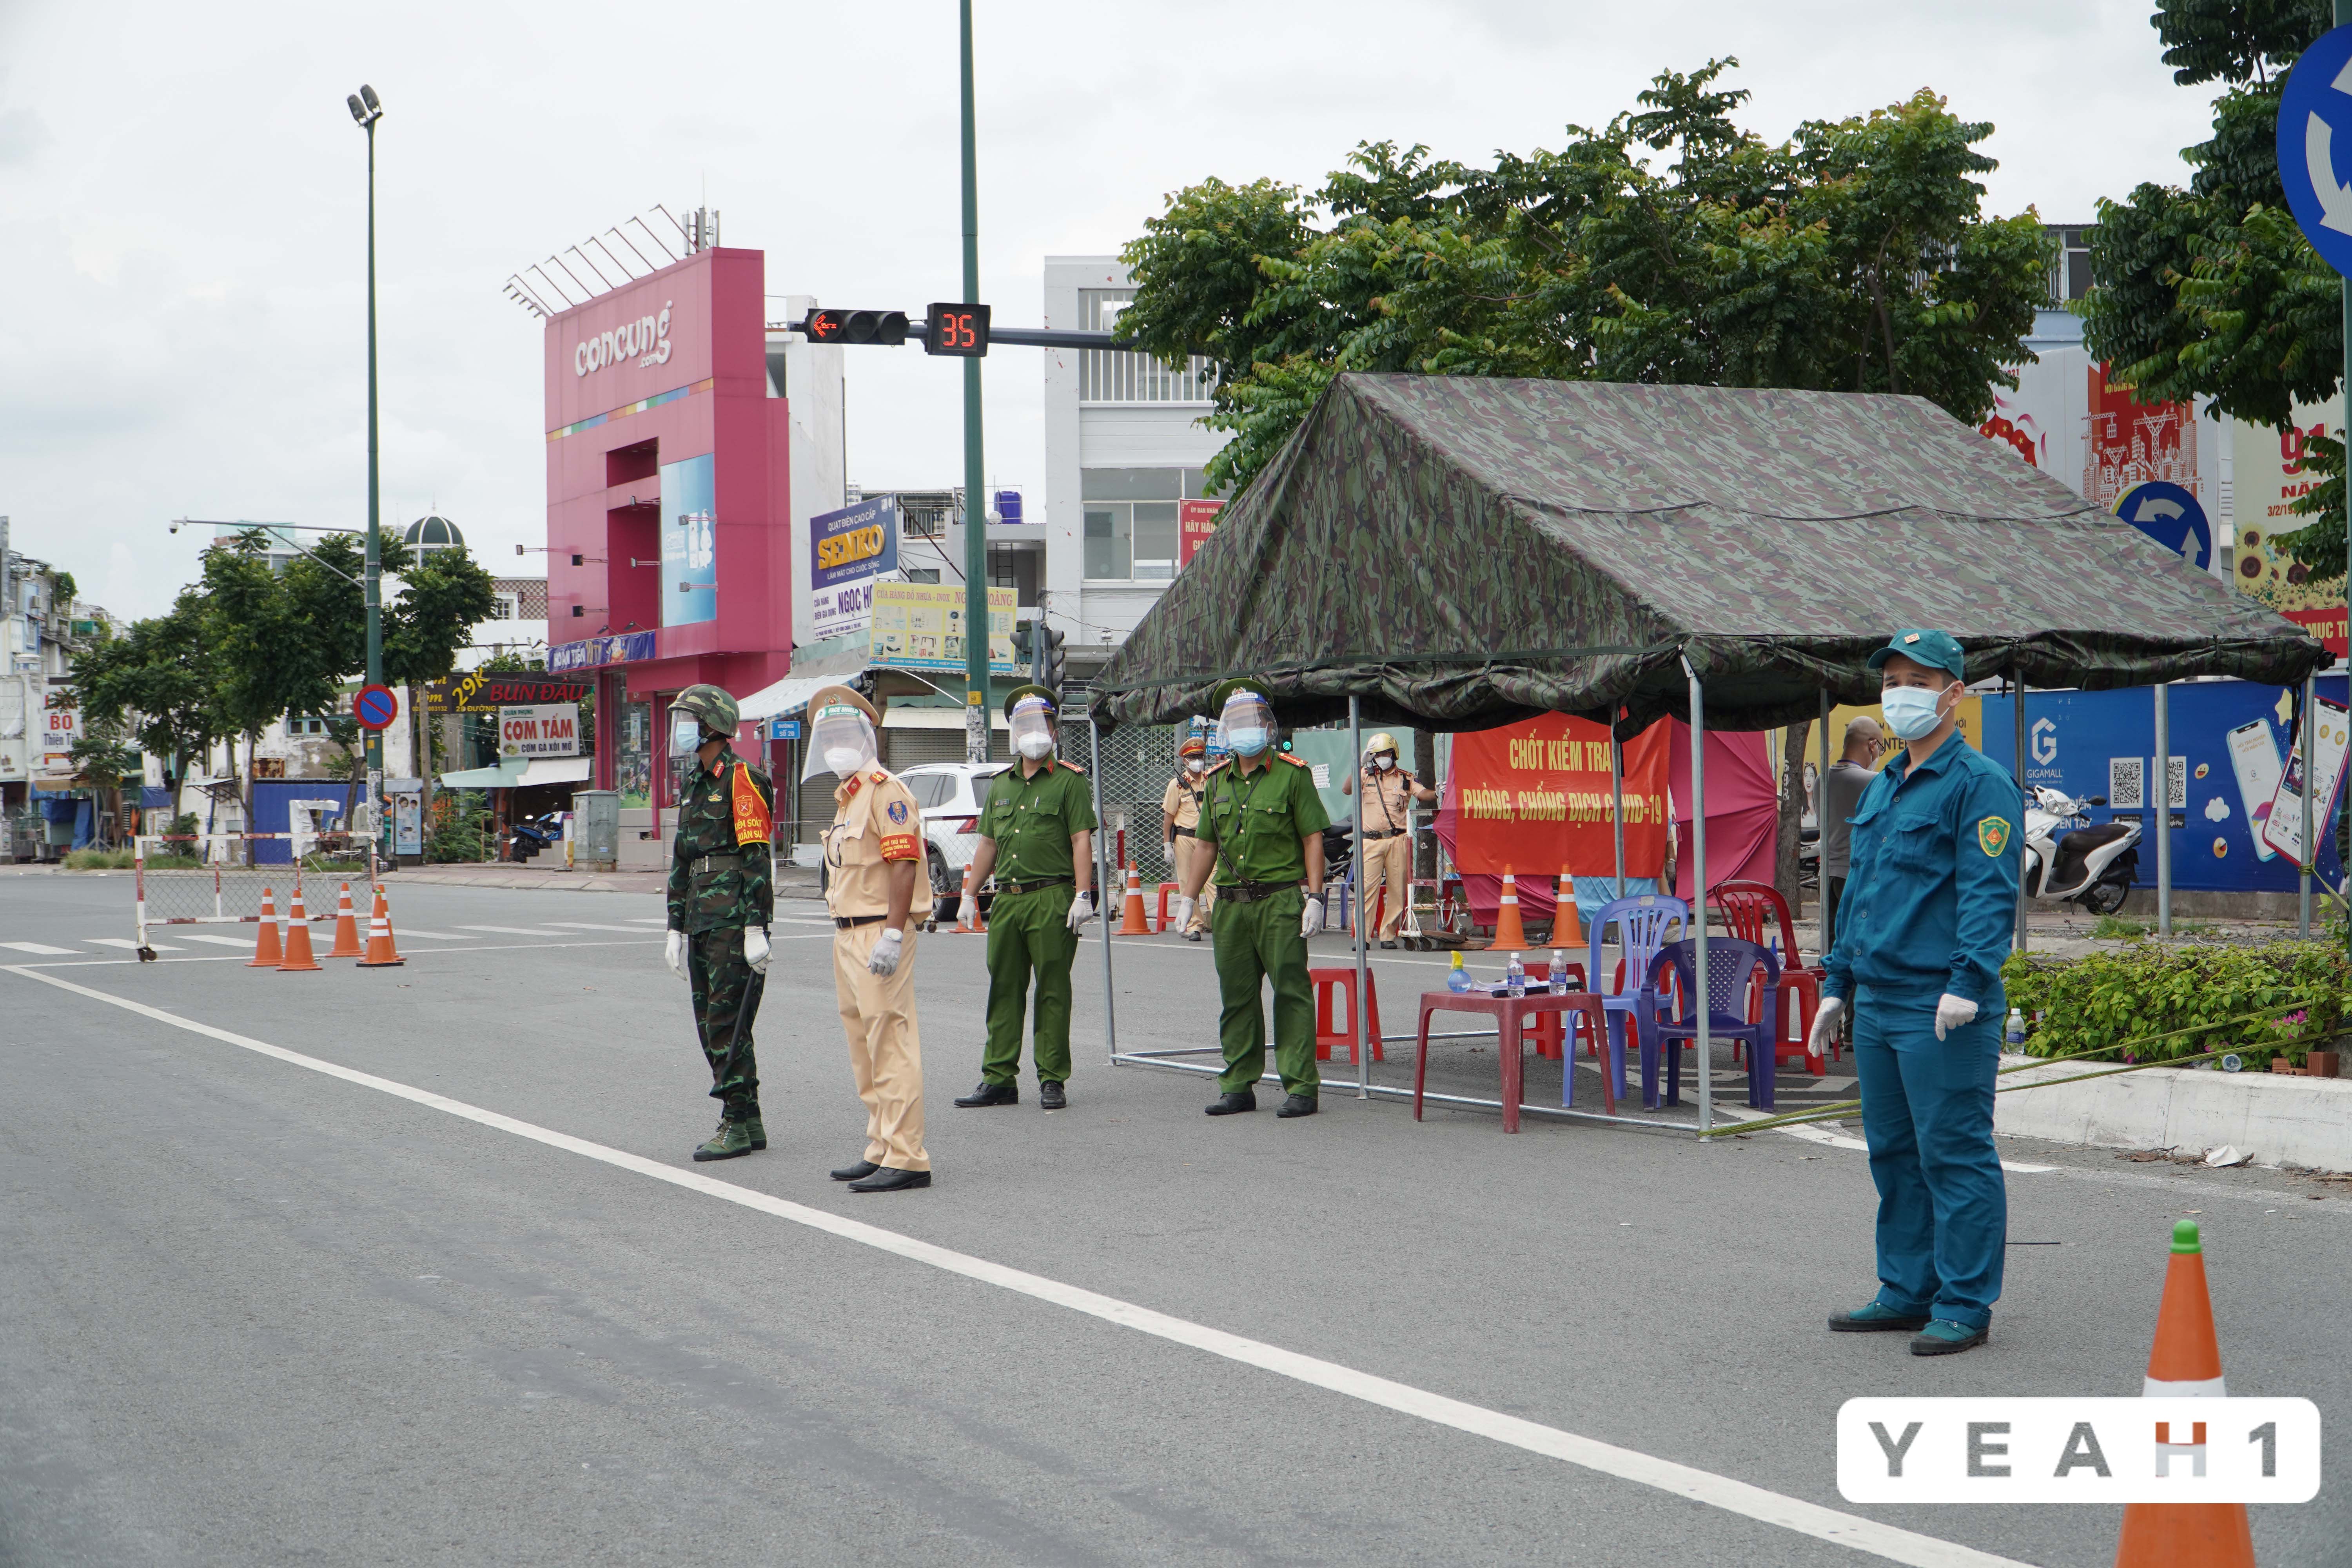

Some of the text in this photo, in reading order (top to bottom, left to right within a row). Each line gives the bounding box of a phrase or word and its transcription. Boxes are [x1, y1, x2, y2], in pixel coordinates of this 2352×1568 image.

[942, 313, 975, 348] 35
[854, 513, 866, 524] CAO
[866, 508, 877, 521] CẤP
[1185, 520, 1200, 533] HÃY
[818, 524, 885, 570] SENKO
[846, 567, 855, 575] CHO
[838, 588, 861, 618] NGỌC
[889, 589, 905, 600] HÀNG
[936, 593, 951, 602] INOX
[987, 590, 1013, 606] OÀNG
[452, 667, 490, 706] 29K
[490, 679, 536, 702] BÚN
[504, 713, 573, 741] CƠM TẤM
[522, 743, 536, 753] CƠM
[539, 742, 547, 752] GÀ
[1510, 728, 1613, 772] CHỐT KIỂM TRA
[2027, 769, 2063, 779] GIGAMALL
[1463, 781, 1662, 828] PHÒNG, CHỐNG DỊCH CVID-19
[747, 817, 762, 827] SOÁT
